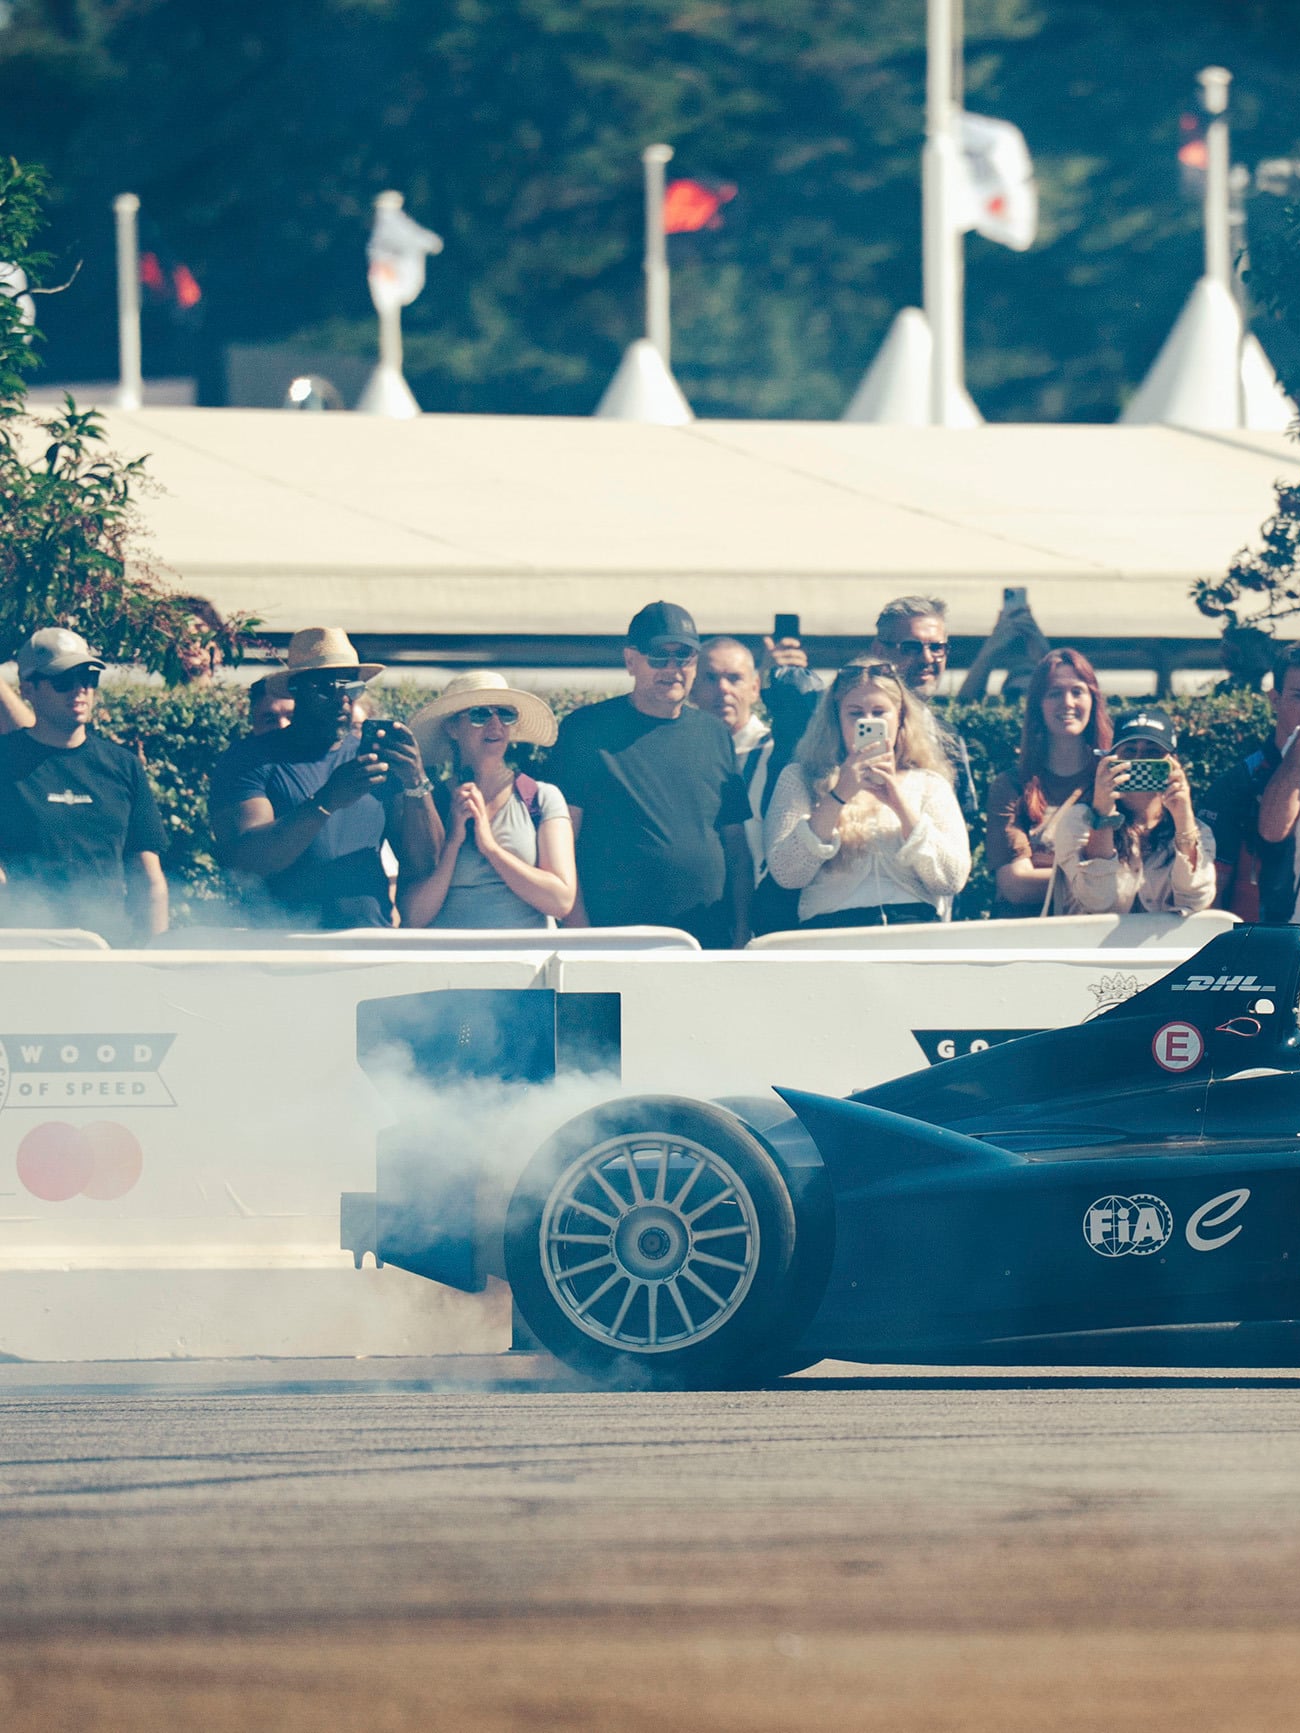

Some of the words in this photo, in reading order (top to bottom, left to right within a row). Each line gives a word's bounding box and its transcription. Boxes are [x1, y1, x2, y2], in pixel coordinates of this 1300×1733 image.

[1184, 975, 1262, 991] DHL
[20, 1044, 153, 1064] WOOD
[936, 1039, 990, 1059] GO
[1165, 1031, 1189, 1062] E
[19, 1082, 49, 1097] OF
[65, 1081, 147, 1096] SPEED
